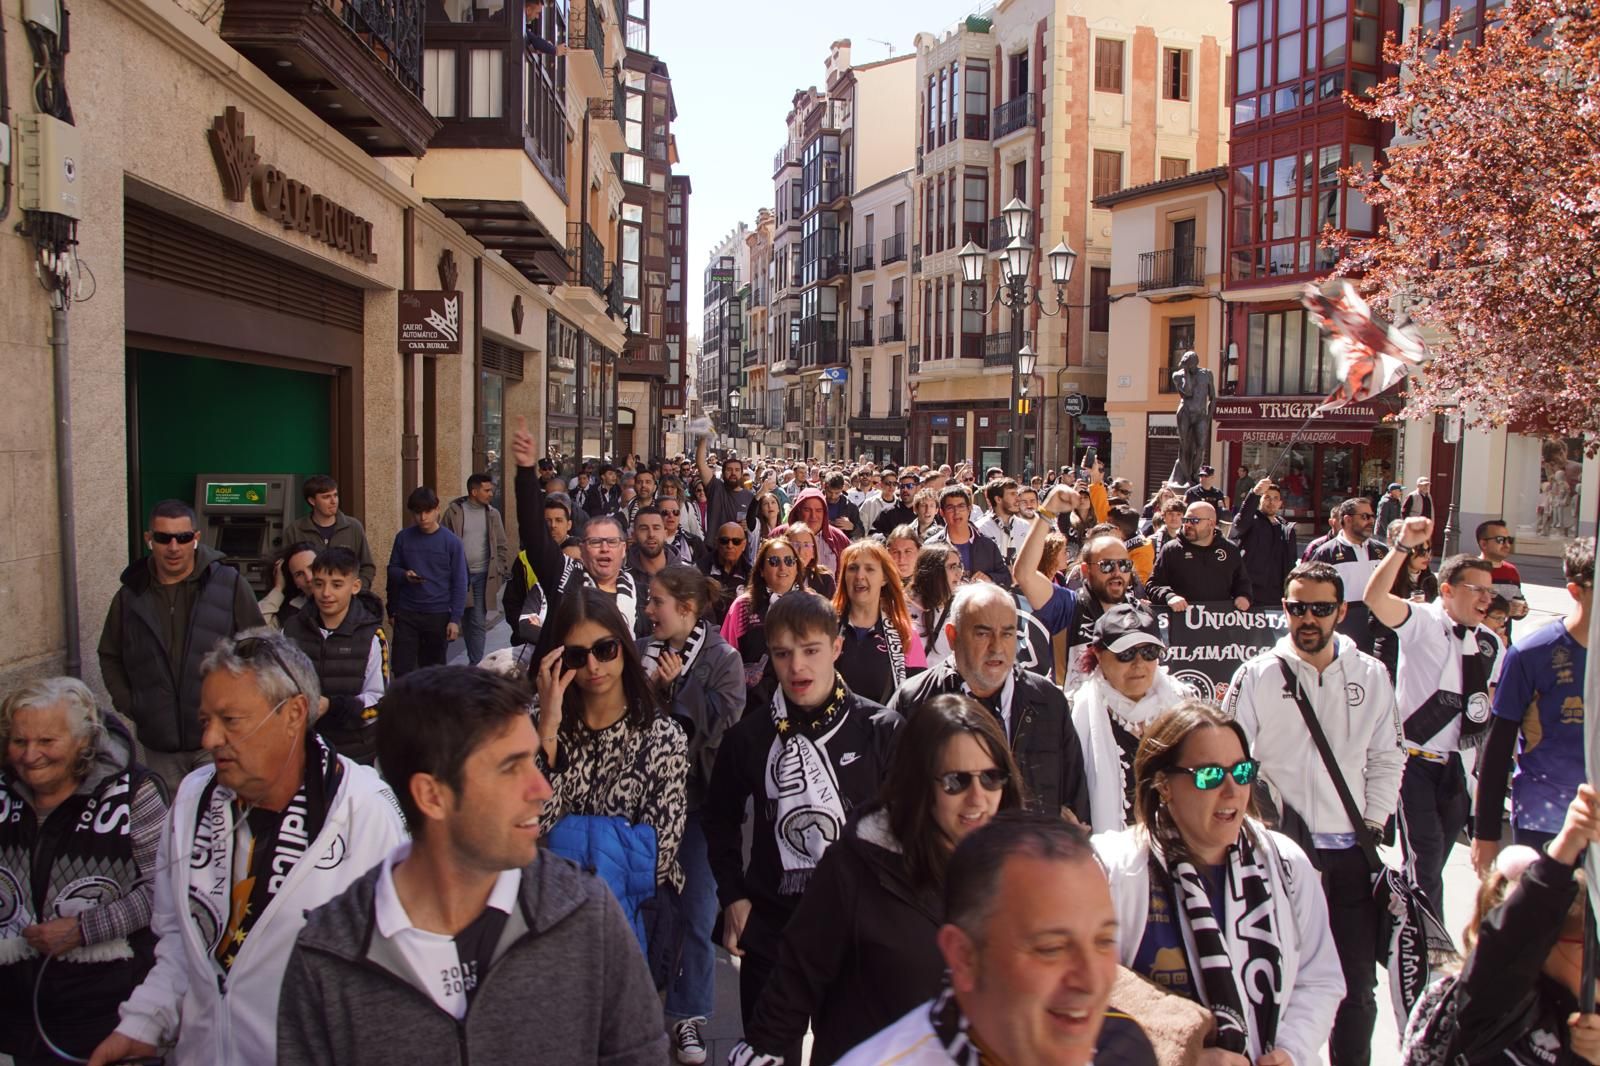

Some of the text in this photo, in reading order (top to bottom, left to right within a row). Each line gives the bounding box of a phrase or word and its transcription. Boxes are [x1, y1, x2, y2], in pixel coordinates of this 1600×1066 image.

[251, 164, 378, 264] CAJA RURAL
[402, 323, 423, 331] CAJERO
[408, 342, 449, 350] CAJA RURAL
[1216, 406, 1253, 415] PANADERIA
[1329, 408, 1375, 416] PASTELERIA
[1242, 431, 1336, 442] PASTELERIA PANADERIA
[1185, 604, 1289, 631] UNIONISTA
